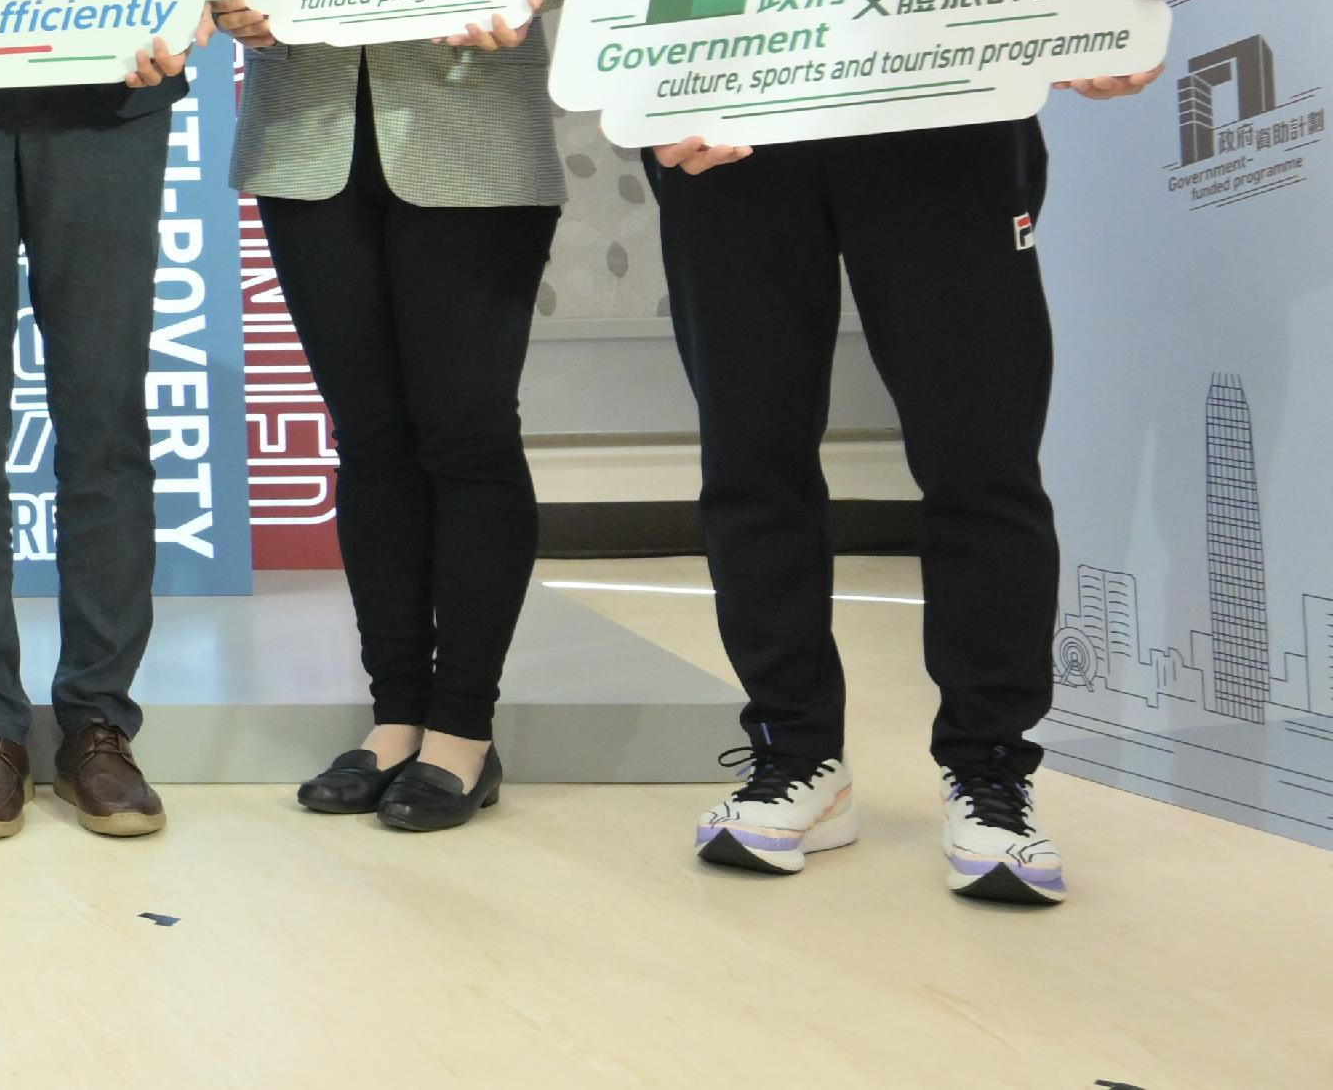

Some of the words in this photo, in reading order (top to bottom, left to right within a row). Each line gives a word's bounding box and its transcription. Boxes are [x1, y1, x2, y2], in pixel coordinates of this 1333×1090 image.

[597, 22, 830, 72] Government
[656, 67, 744, 99] culture,
[749, 55, 826, 93] sports
[830, 50, 878, 80] and
[880, 44, 975, 73] tourism
[978, 30, 1130, 71] programme
[1218, 108, 1325, 153] 政府資助計劃
[1168, 156, 1254, 192] Government-
[1192, 177, 1231, 201] funded
[1234, 157, 1303, 190] programme
